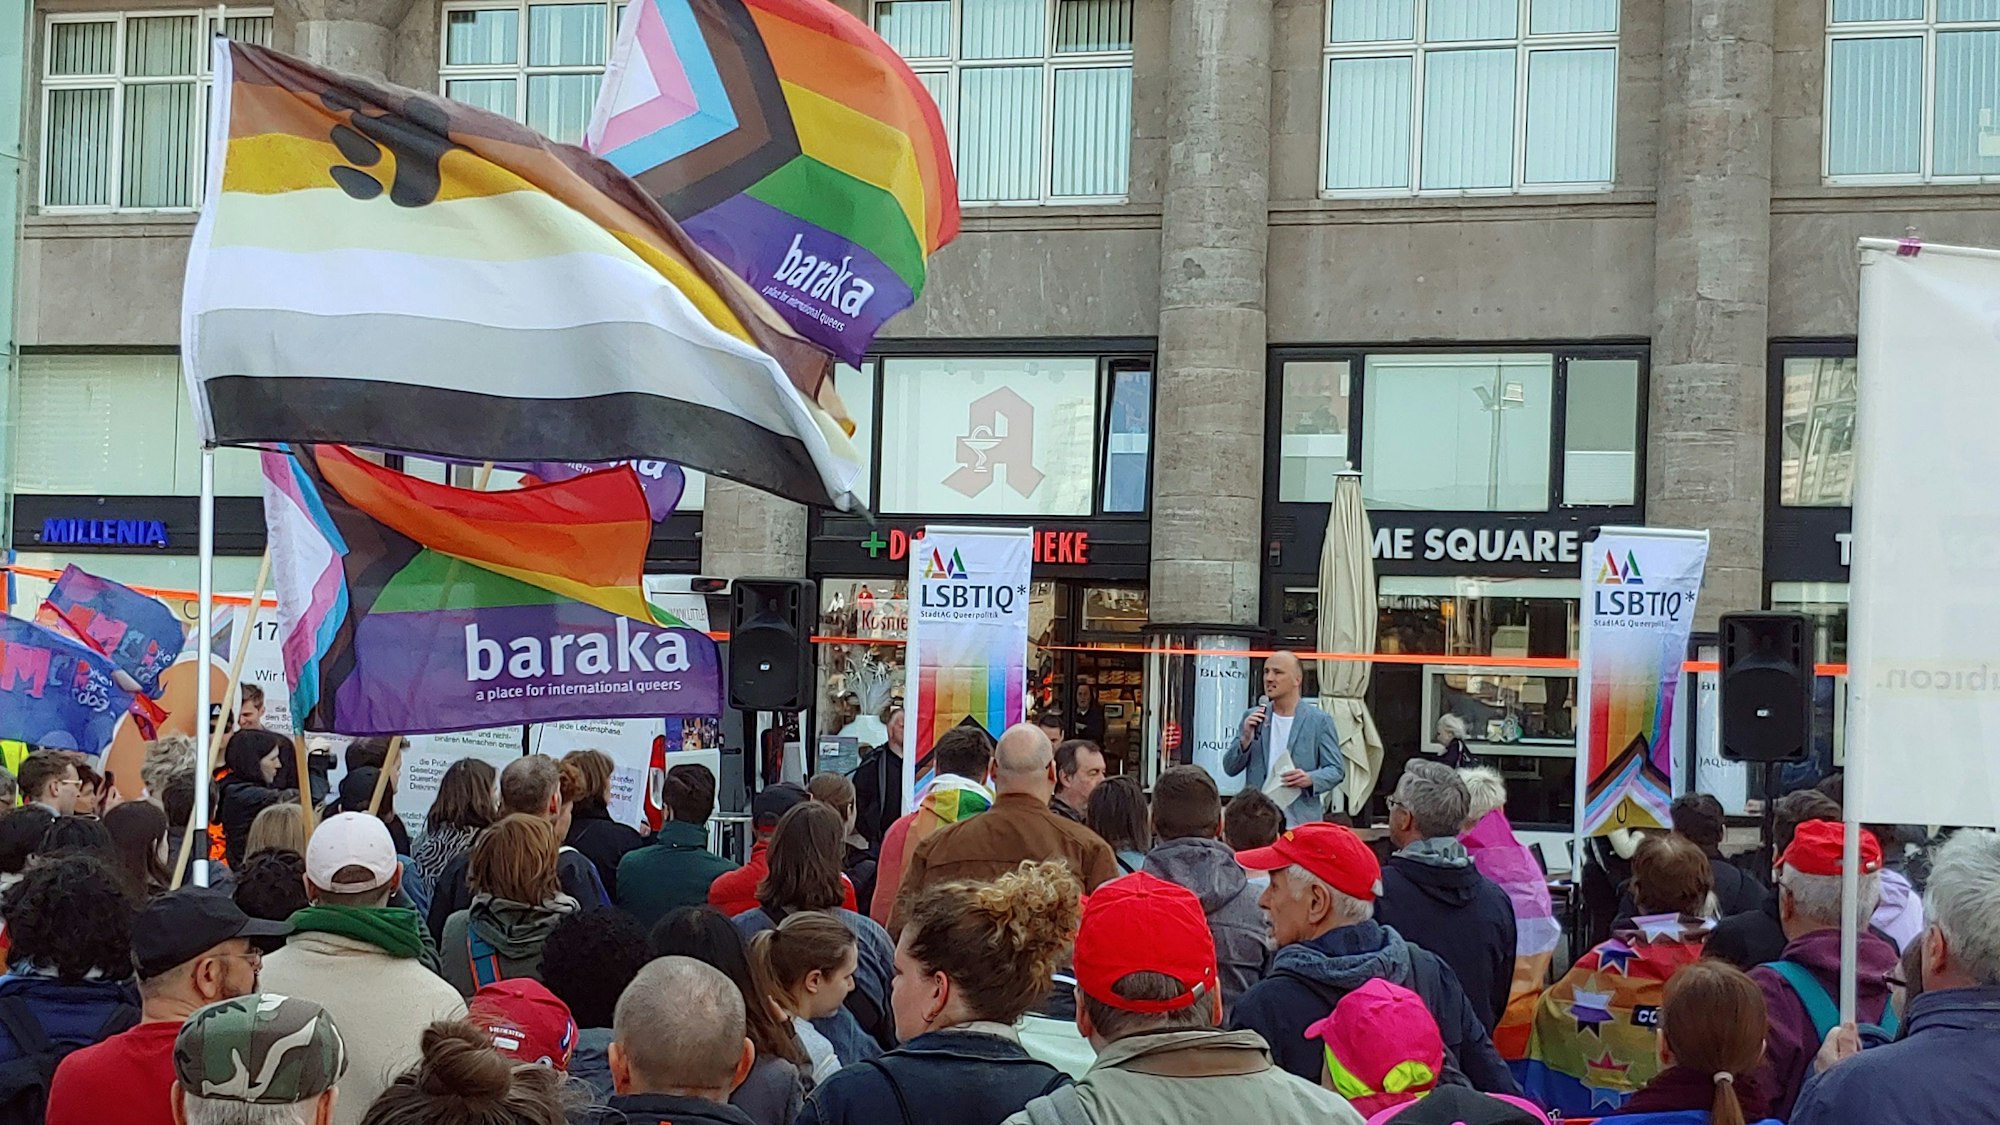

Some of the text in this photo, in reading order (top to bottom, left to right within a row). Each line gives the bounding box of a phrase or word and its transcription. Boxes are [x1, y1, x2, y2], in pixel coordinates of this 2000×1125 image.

[773, 233, 875, 319] baraka
[786, 294, 822, 321] international
[819, 311, 846, 333] queers
[42, 517, 169, 545] MILLENIA
[1423, 527, 1579, 563] SQUARE
[920, 610, 999, 620] StadtAG Queerpolitik
[464, 616, 692, 682] baraka
[255, 670, 278, 682] Wir
[475, 679, 682, 703] a place for international queers
[462, 737, 498, 748] Menschen
